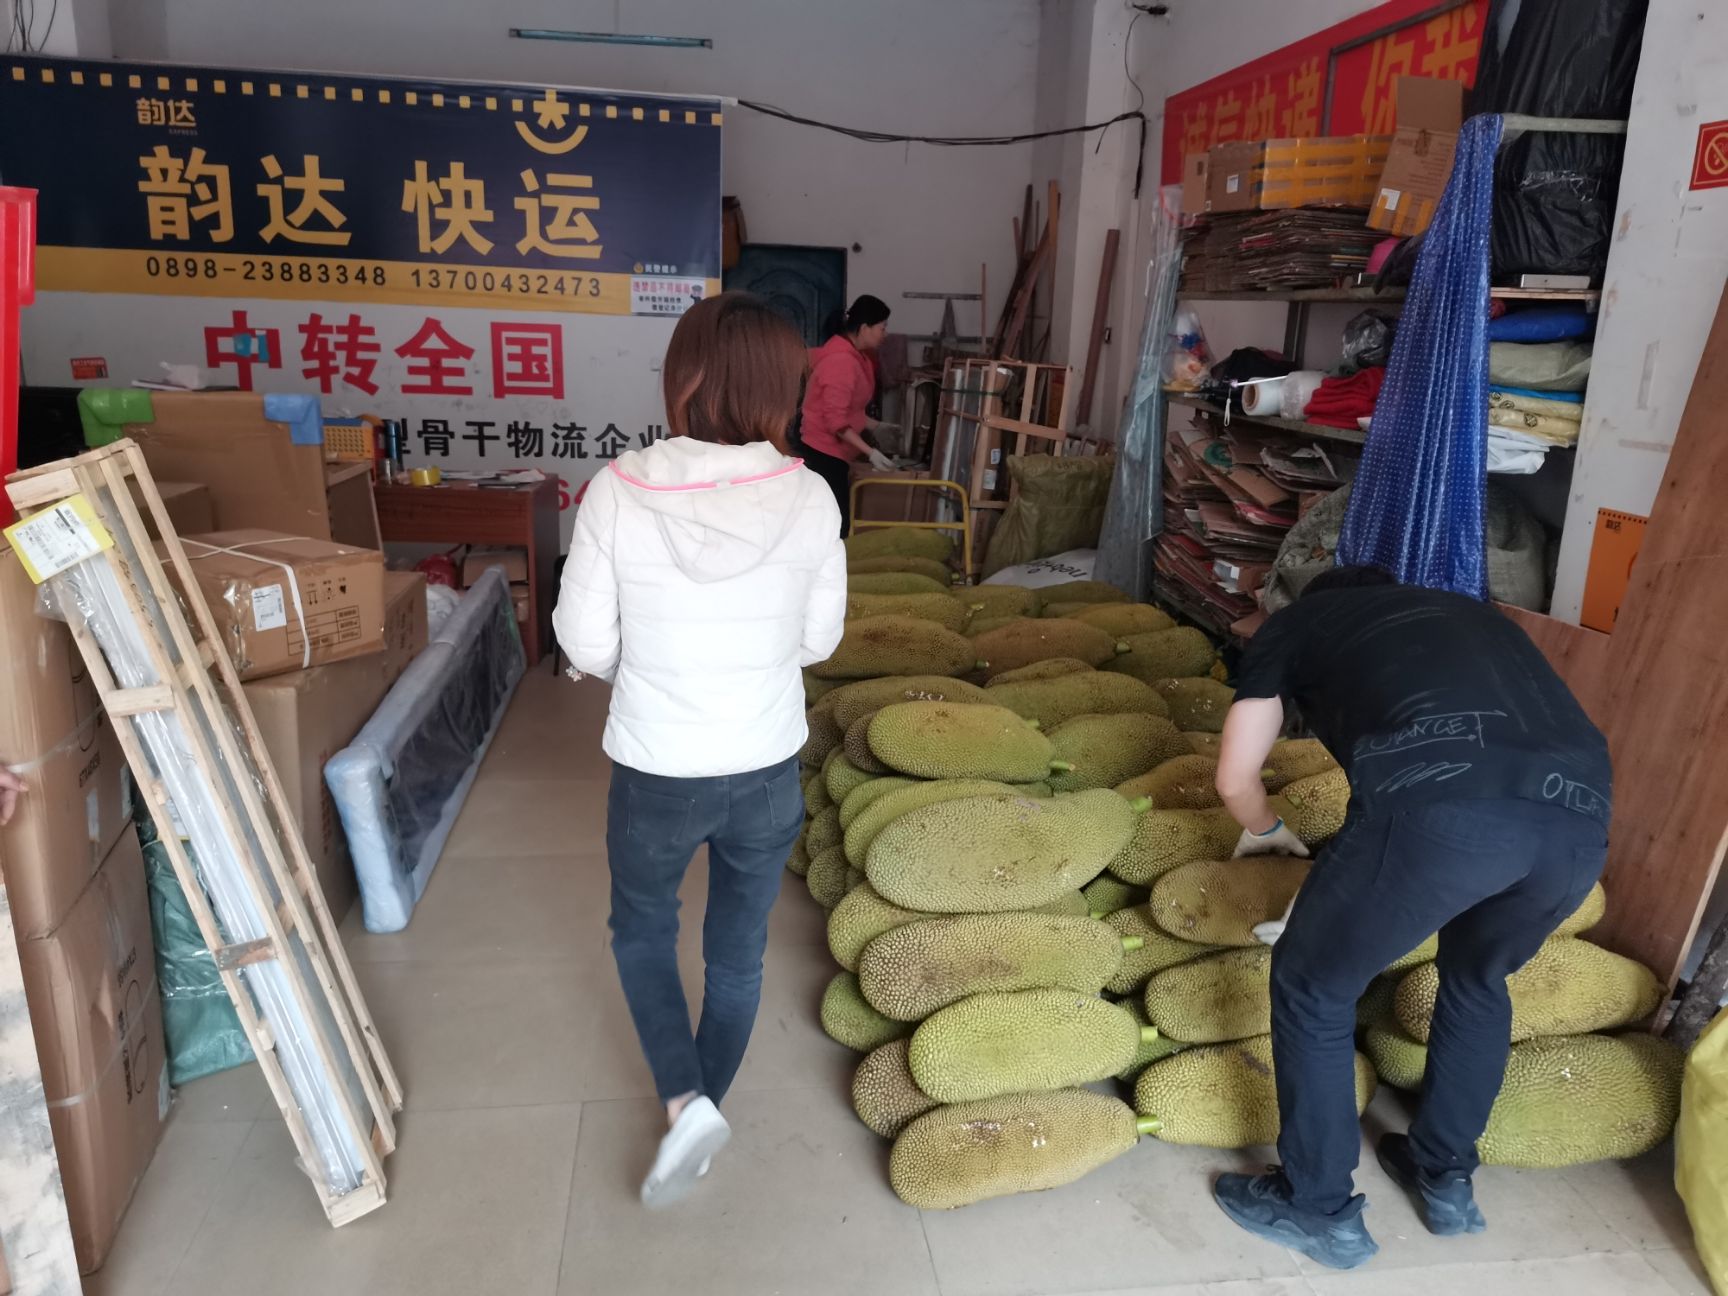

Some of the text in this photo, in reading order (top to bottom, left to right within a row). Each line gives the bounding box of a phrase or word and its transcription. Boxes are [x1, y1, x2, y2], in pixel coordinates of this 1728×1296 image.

[136, 98, 197, 127] 韵达
[138, 145, 603, 259] 韵达 快运
[146, 256, 601, 297] 0898-23883348 13700432473
[204, 310, 565, 400] 中转全国
